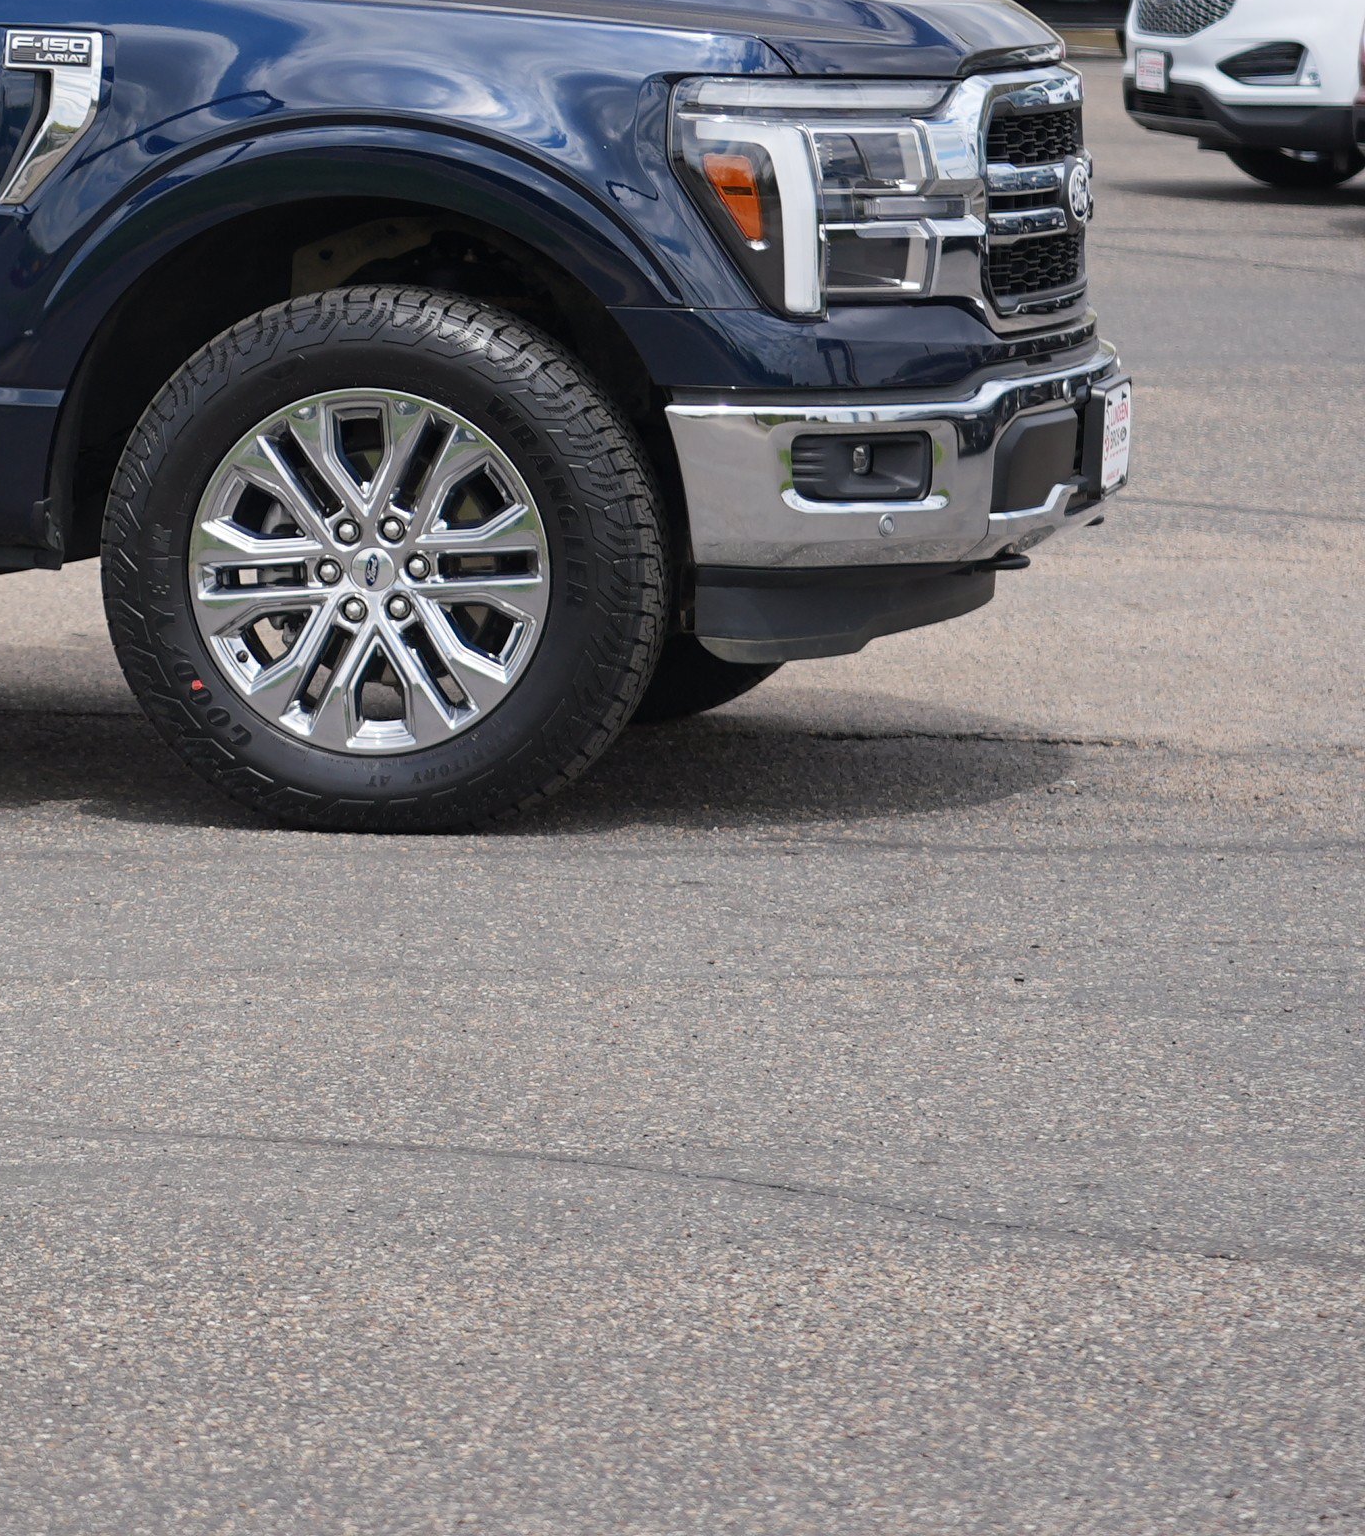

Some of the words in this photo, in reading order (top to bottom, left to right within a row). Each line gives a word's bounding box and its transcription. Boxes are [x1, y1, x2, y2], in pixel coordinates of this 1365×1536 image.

[12, 36, 90, 53] F-150
[35, 52, 87, 63] LARIAT
[484, 394, 588, 607] WRANGLER
[146, 522, 252, 747] GOODYEAR
